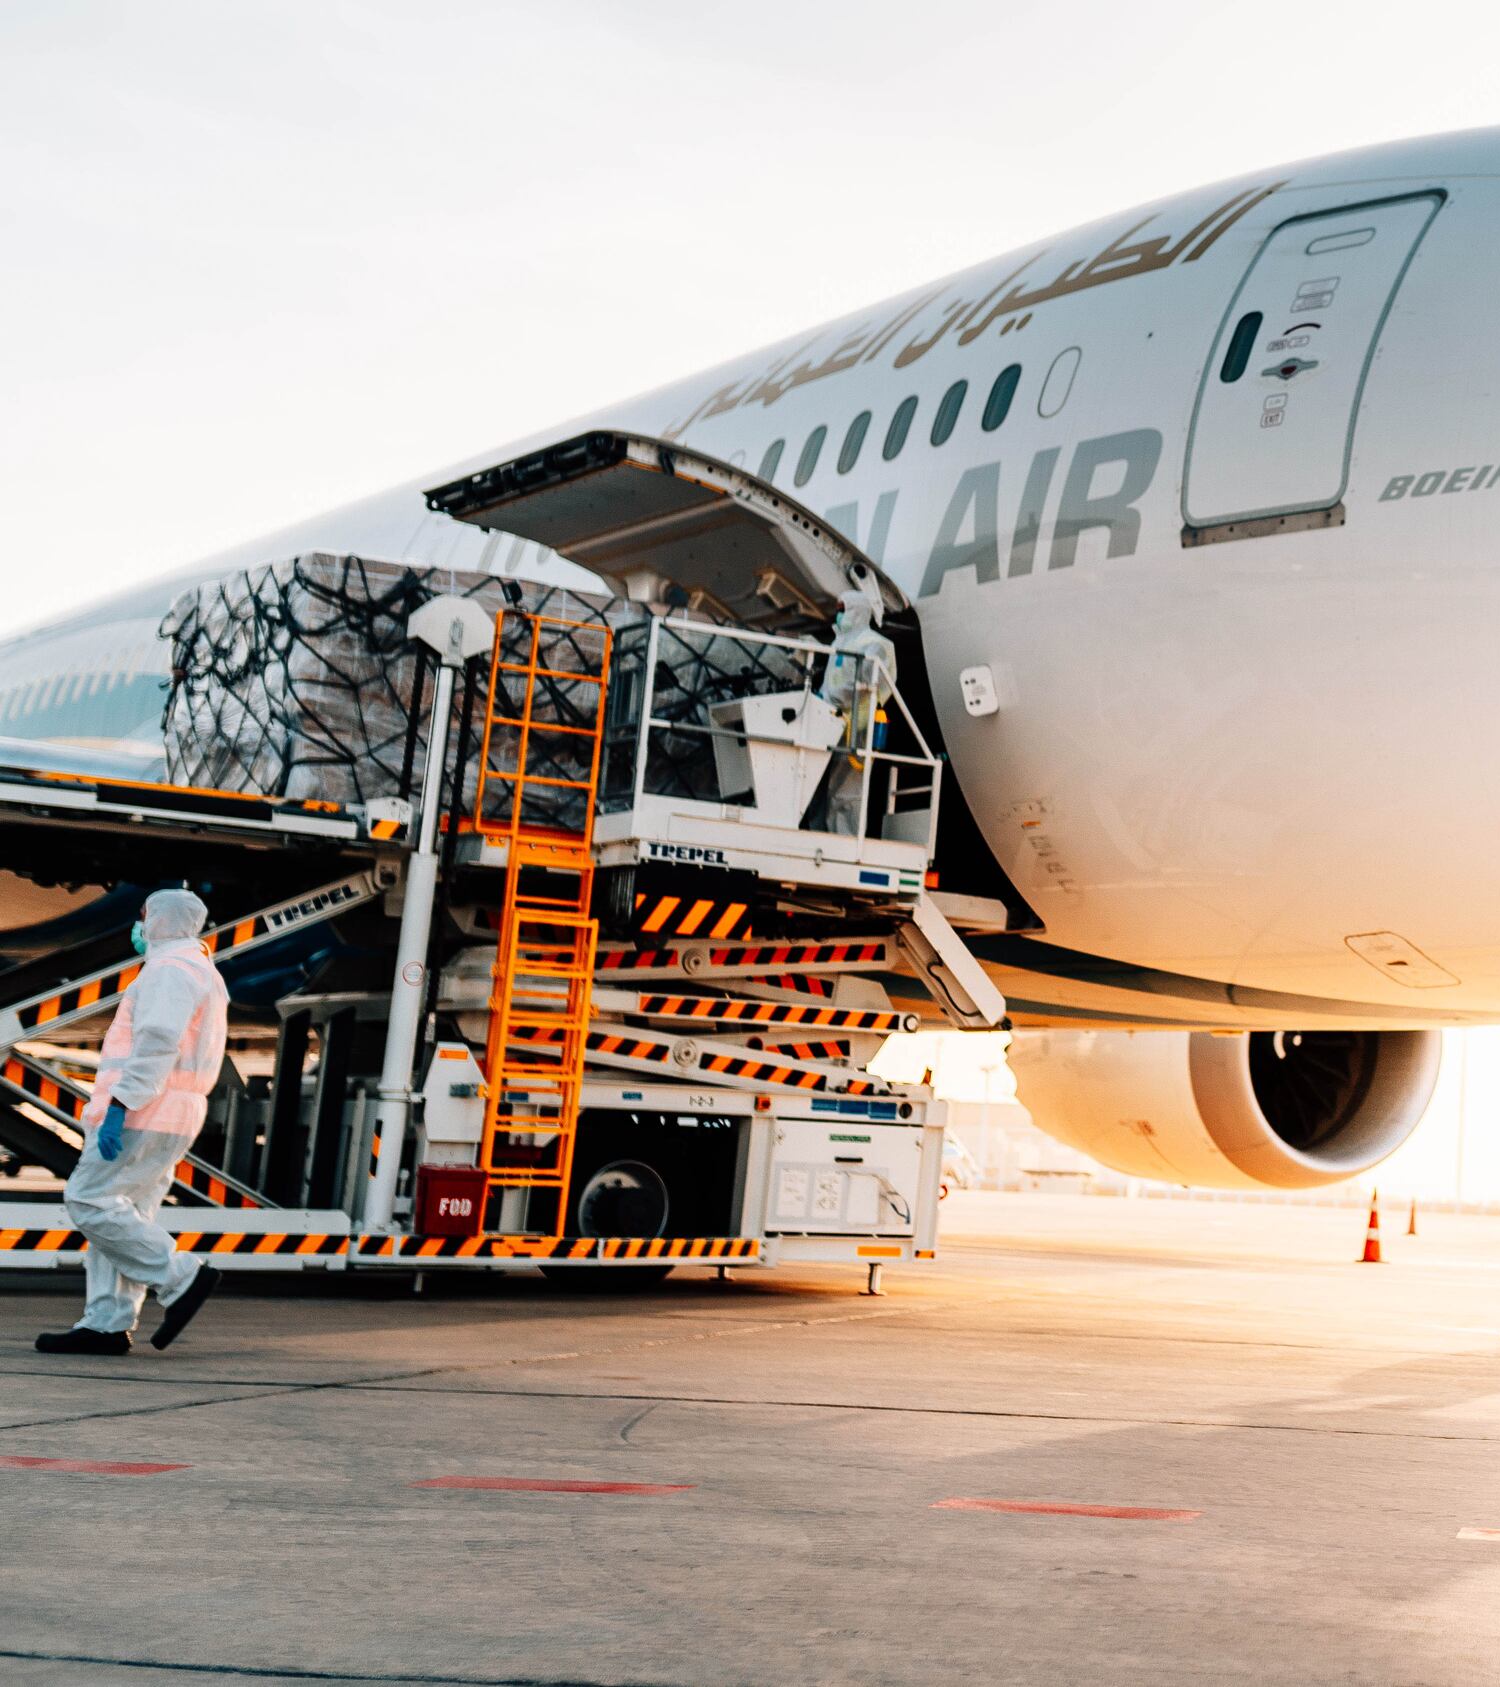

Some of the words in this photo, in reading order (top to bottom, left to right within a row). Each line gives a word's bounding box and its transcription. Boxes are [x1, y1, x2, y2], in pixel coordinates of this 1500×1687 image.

[917, 427, 1164, 599] AIR
[649, 842, 728, 864] TREPEL
[268, 884, 360, 927] TREPEL
[439, 1198, 472, 1216] FOD
